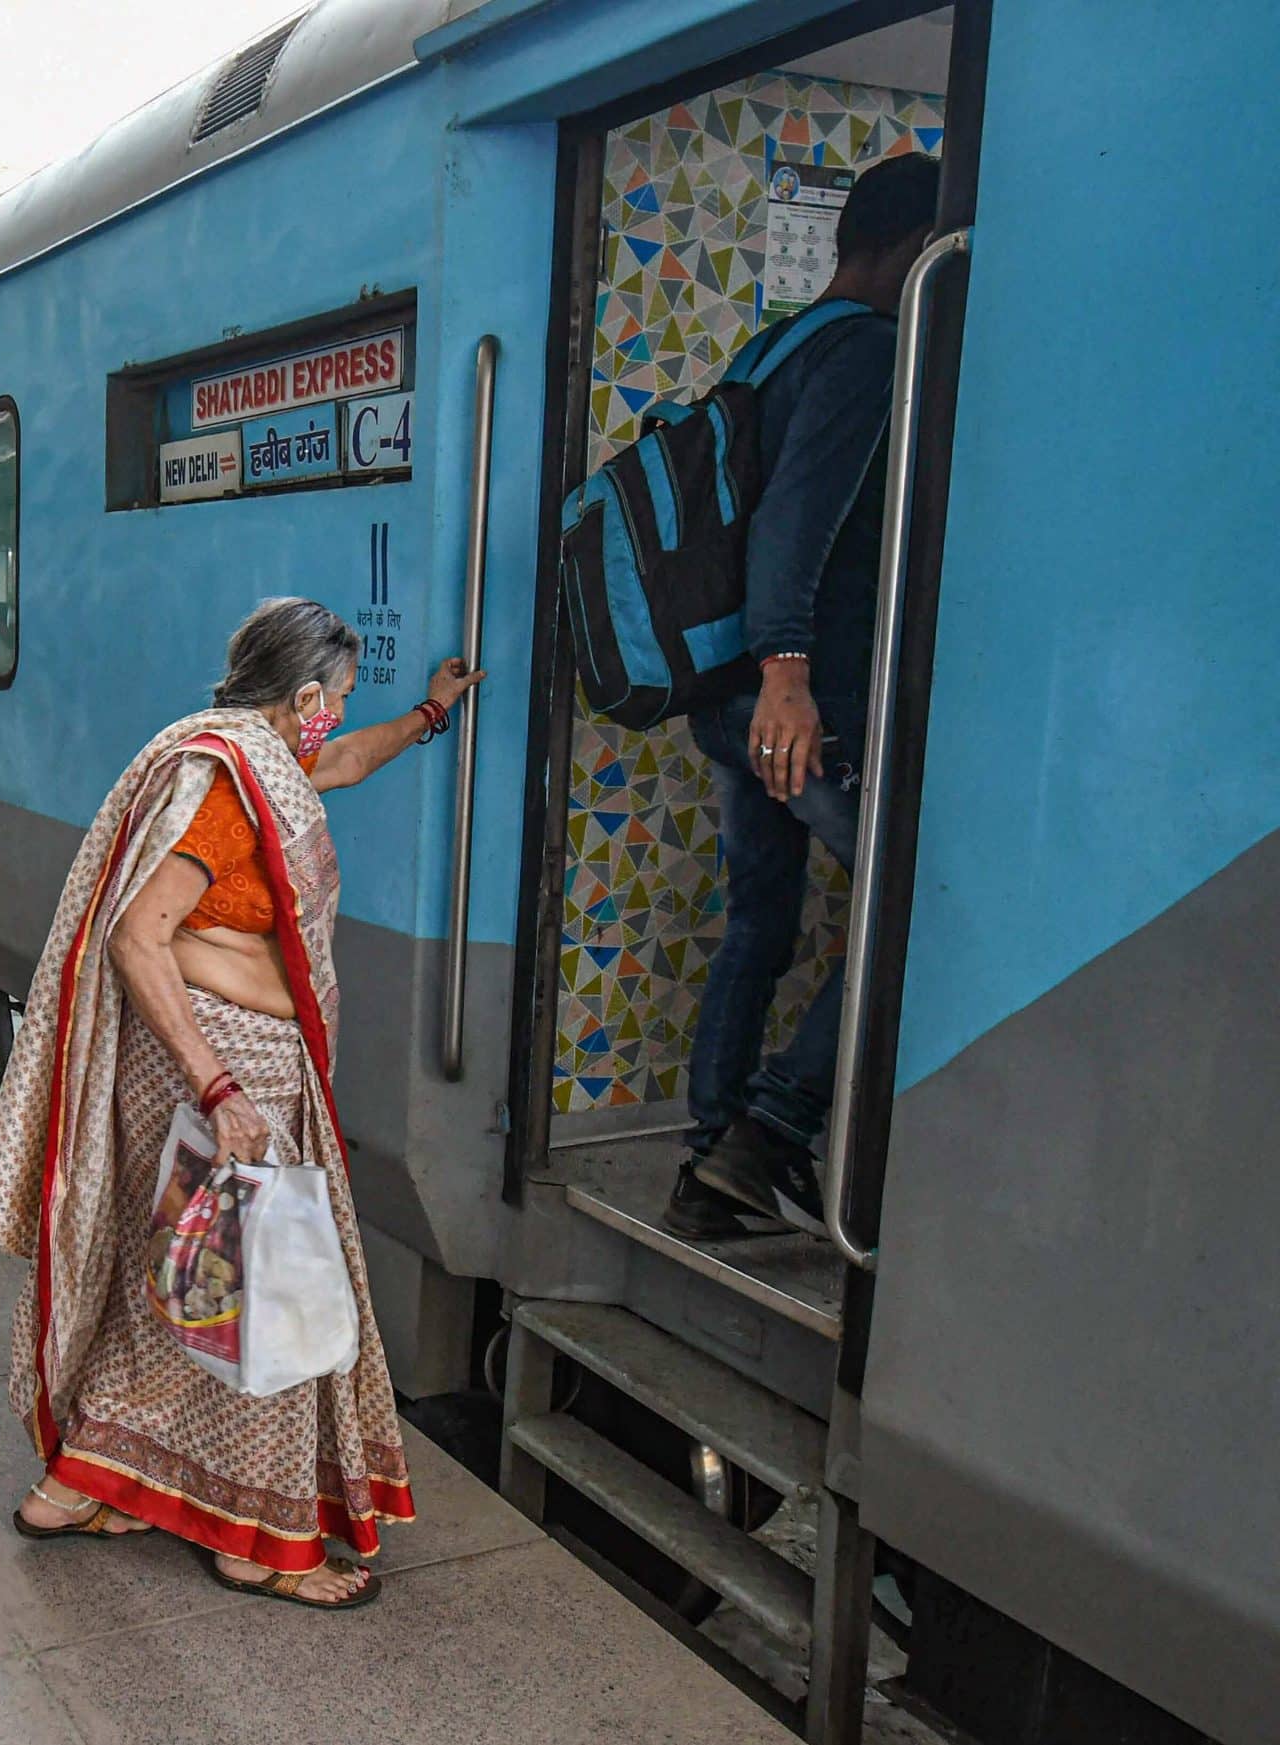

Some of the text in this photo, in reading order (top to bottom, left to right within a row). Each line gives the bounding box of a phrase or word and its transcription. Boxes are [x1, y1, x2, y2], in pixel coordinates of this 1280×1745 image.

[196, 339, 396, 420] SHATABDI EXPRESS
[249, 420, 330, 477] हबीब गंज
[352, 400, 411, 467] C-4
[165, 451, 218, 487] NEW DELHI
[363, 634, 396, 661] 1-78
[357, 665, 396, 685] TO SEAT
